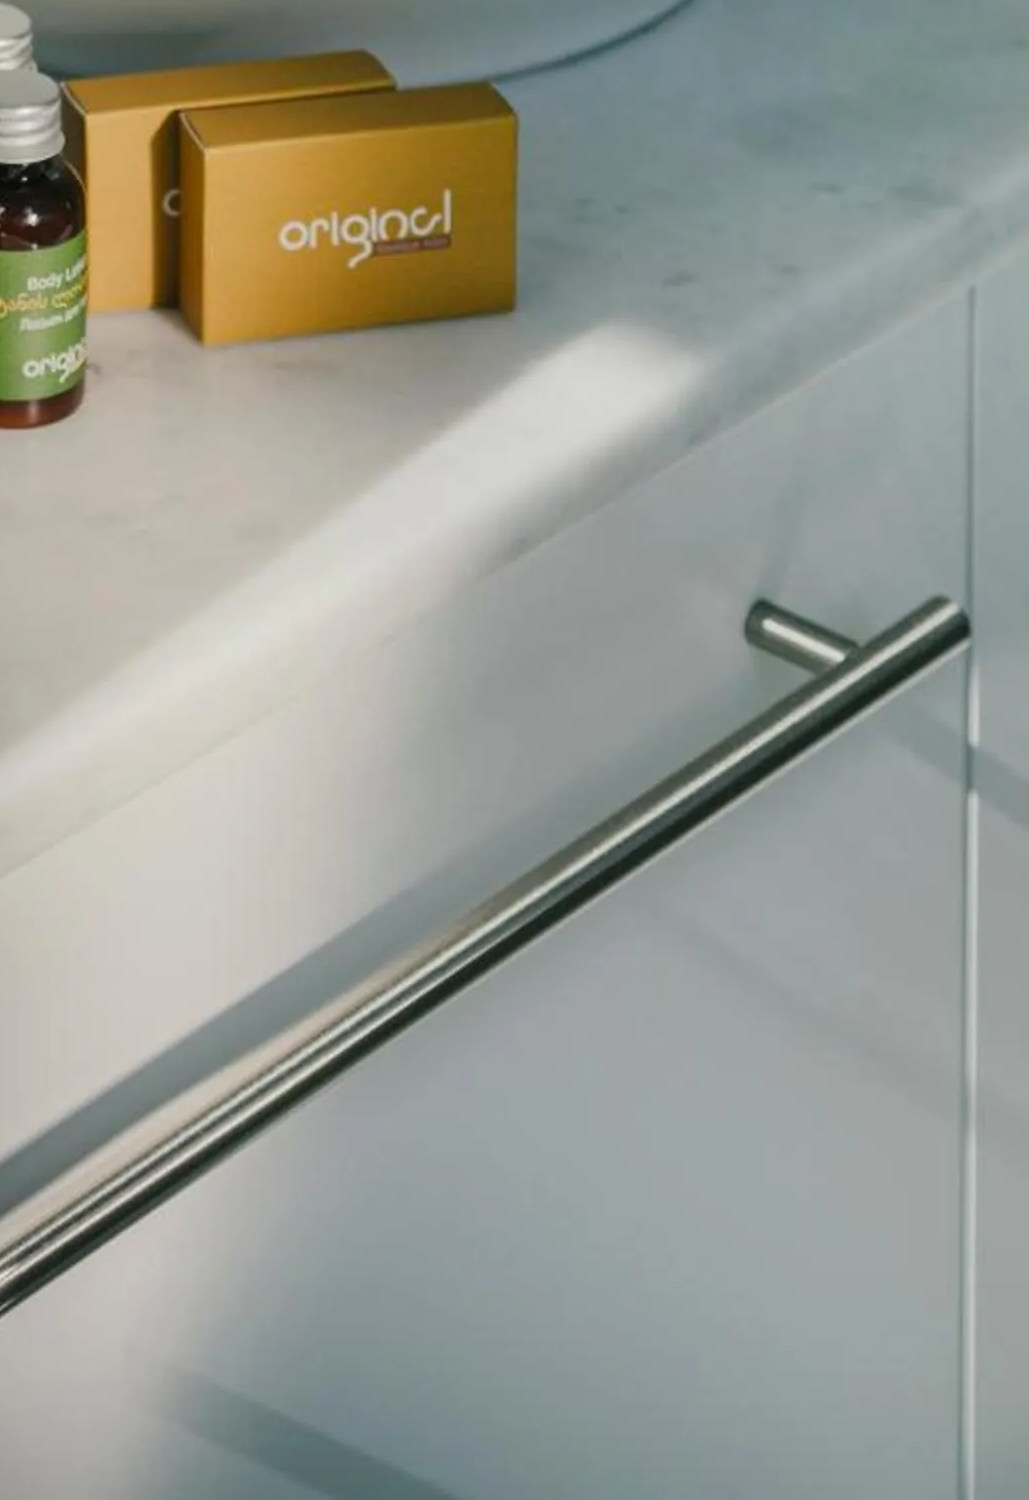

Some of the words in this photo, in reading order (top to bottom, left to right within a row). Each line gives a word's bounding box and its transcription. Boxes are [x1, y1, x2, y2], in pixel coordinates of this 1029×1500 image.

[278, 189, 451, 269] original
[27, 271, 63, 292] Body
[22, 338, 88, 383] origin
